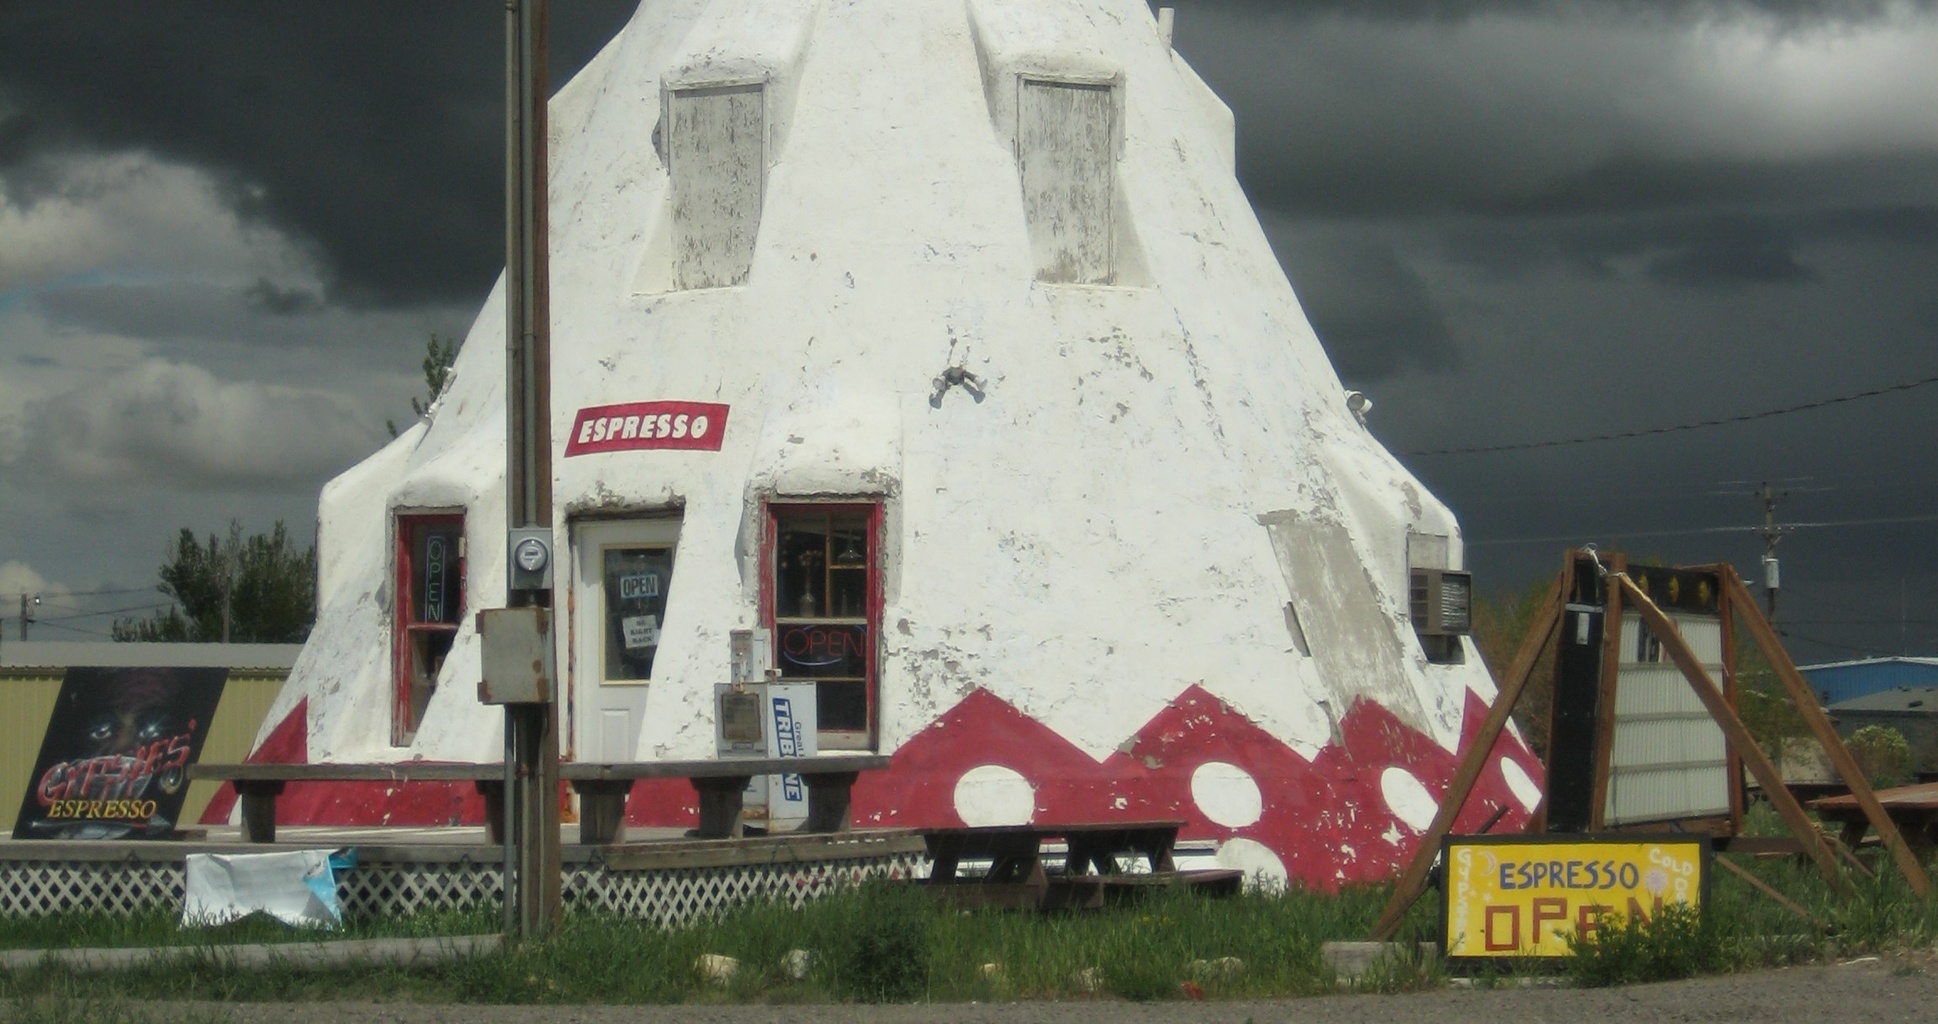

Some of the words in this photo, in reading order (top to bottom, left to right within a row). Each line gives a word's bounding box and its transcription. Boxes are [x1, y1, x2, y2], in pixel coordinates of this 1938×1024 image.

[577, 413, 709, 444] ESPRESSO
[428, 539, 442, 622] OPEN
[623, 575, 655, 596] OPEN
[783, 628, 864, 657] OPEN
[774, 700, 802, 801] TRIBNE
[47, 799, 157, 819] ESPRESSO
[1499, 860, 1640, 890] ESPRESSO
